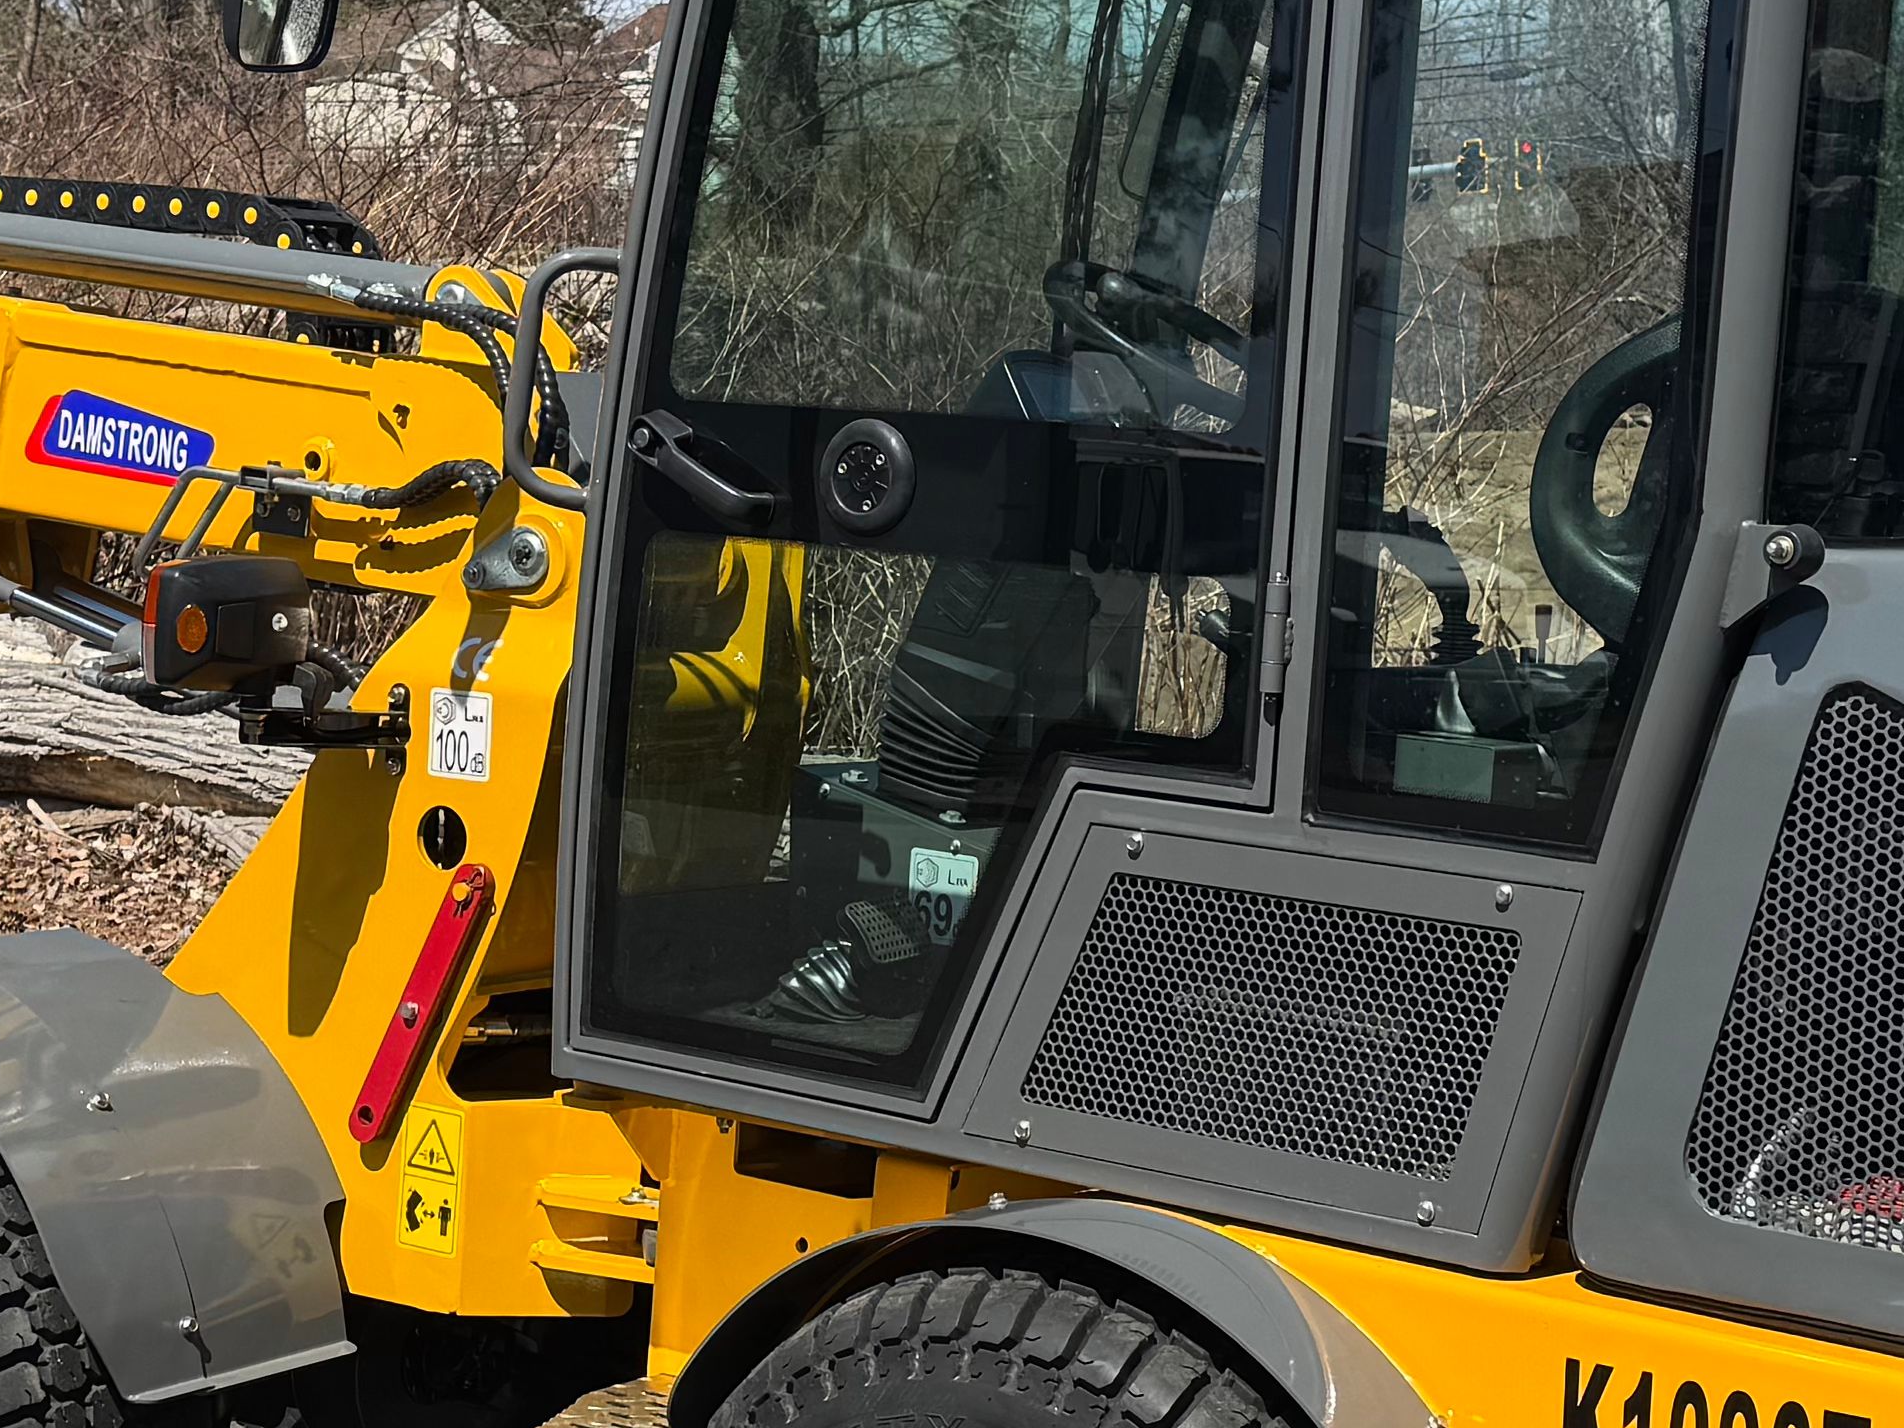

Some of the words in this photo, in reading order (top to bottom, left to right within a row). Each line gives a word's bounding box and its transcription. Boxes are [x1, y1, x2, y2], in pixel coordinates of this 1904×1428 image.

[57, 408, 189, 473] DAMSTRONG
[451, 637, 505, 682] CE
[436, 728, 469, 773] 100
[914, 889, 953, 937] 69
